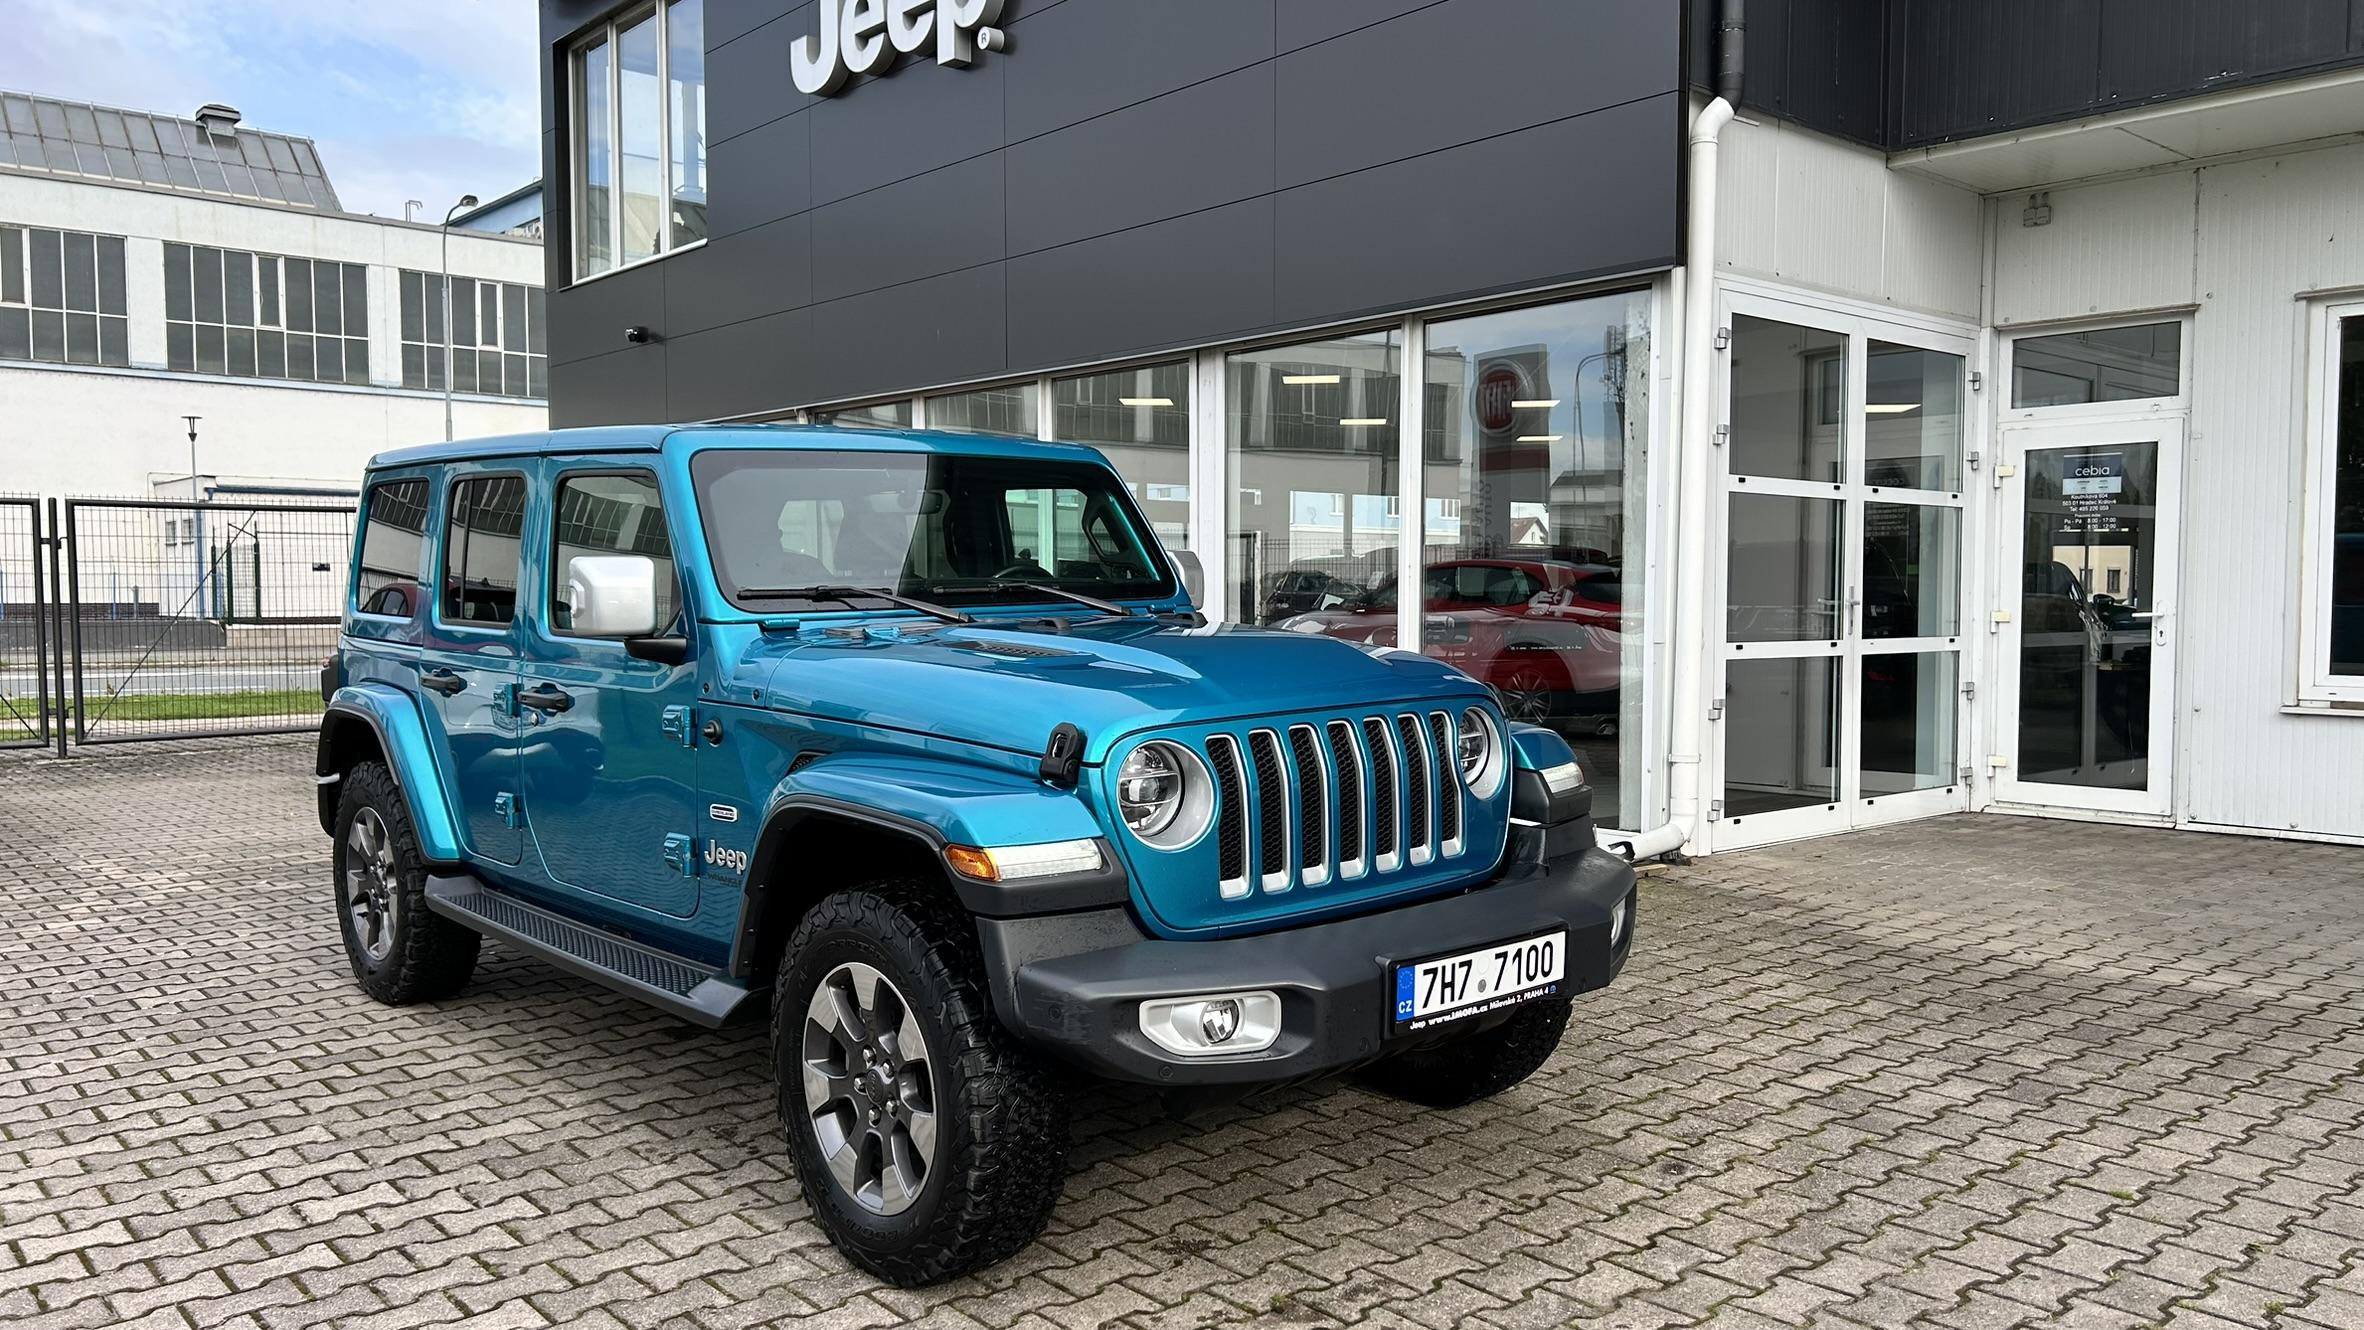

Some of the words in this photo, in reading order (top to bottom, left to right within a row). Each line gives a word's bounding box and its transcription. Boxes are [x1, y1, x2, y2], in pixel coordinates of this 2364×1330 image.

[790, 0, 992, 95] Jeep
[2075, 465, 2110, 476] cebia
[704, 839, 748, 874] Jeep
[1421, 959, 1473, 1009] 7H7
[1493, 940, 1554, 991] 7100
[1398, 1000, 1413, 1015] CZ
[1409, 1020, 1427, 1030] Jeep
[1523, 988, 1544, 1001] PRAHA
[1544, 986, 1549, 994] 4
